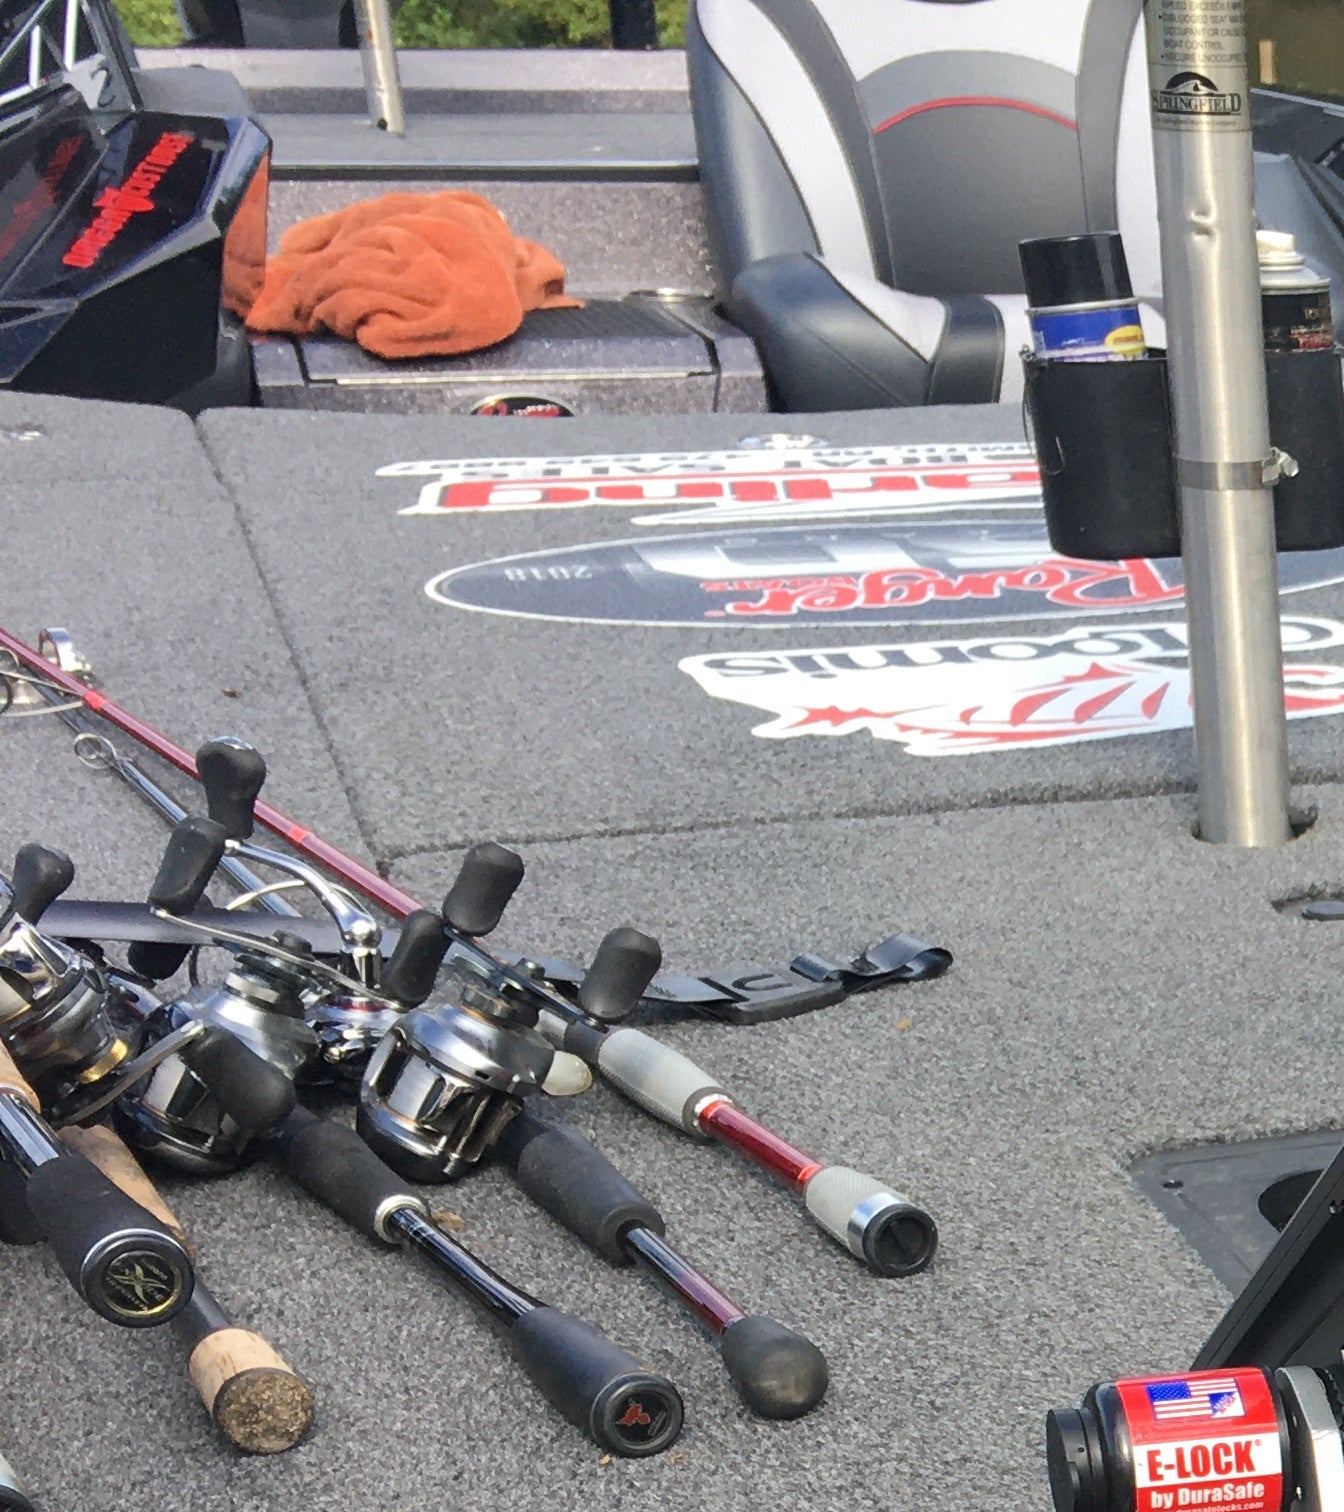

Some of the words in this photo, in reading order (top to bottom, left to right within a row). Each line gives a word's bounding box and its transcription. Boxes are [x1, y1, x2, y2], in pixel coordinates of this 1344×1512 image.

[1152, 93, 1241, 113] SPRINGFIELD
[503, 564, 592, 581] 2018
[725, 555, 1187, 614] Ranger
[1147, 1438, 1255, 1481] E-LOCK
[1151, 1490, 1174, 1509] by
[1177, 1481, 1265, 1506] DuraSafe
